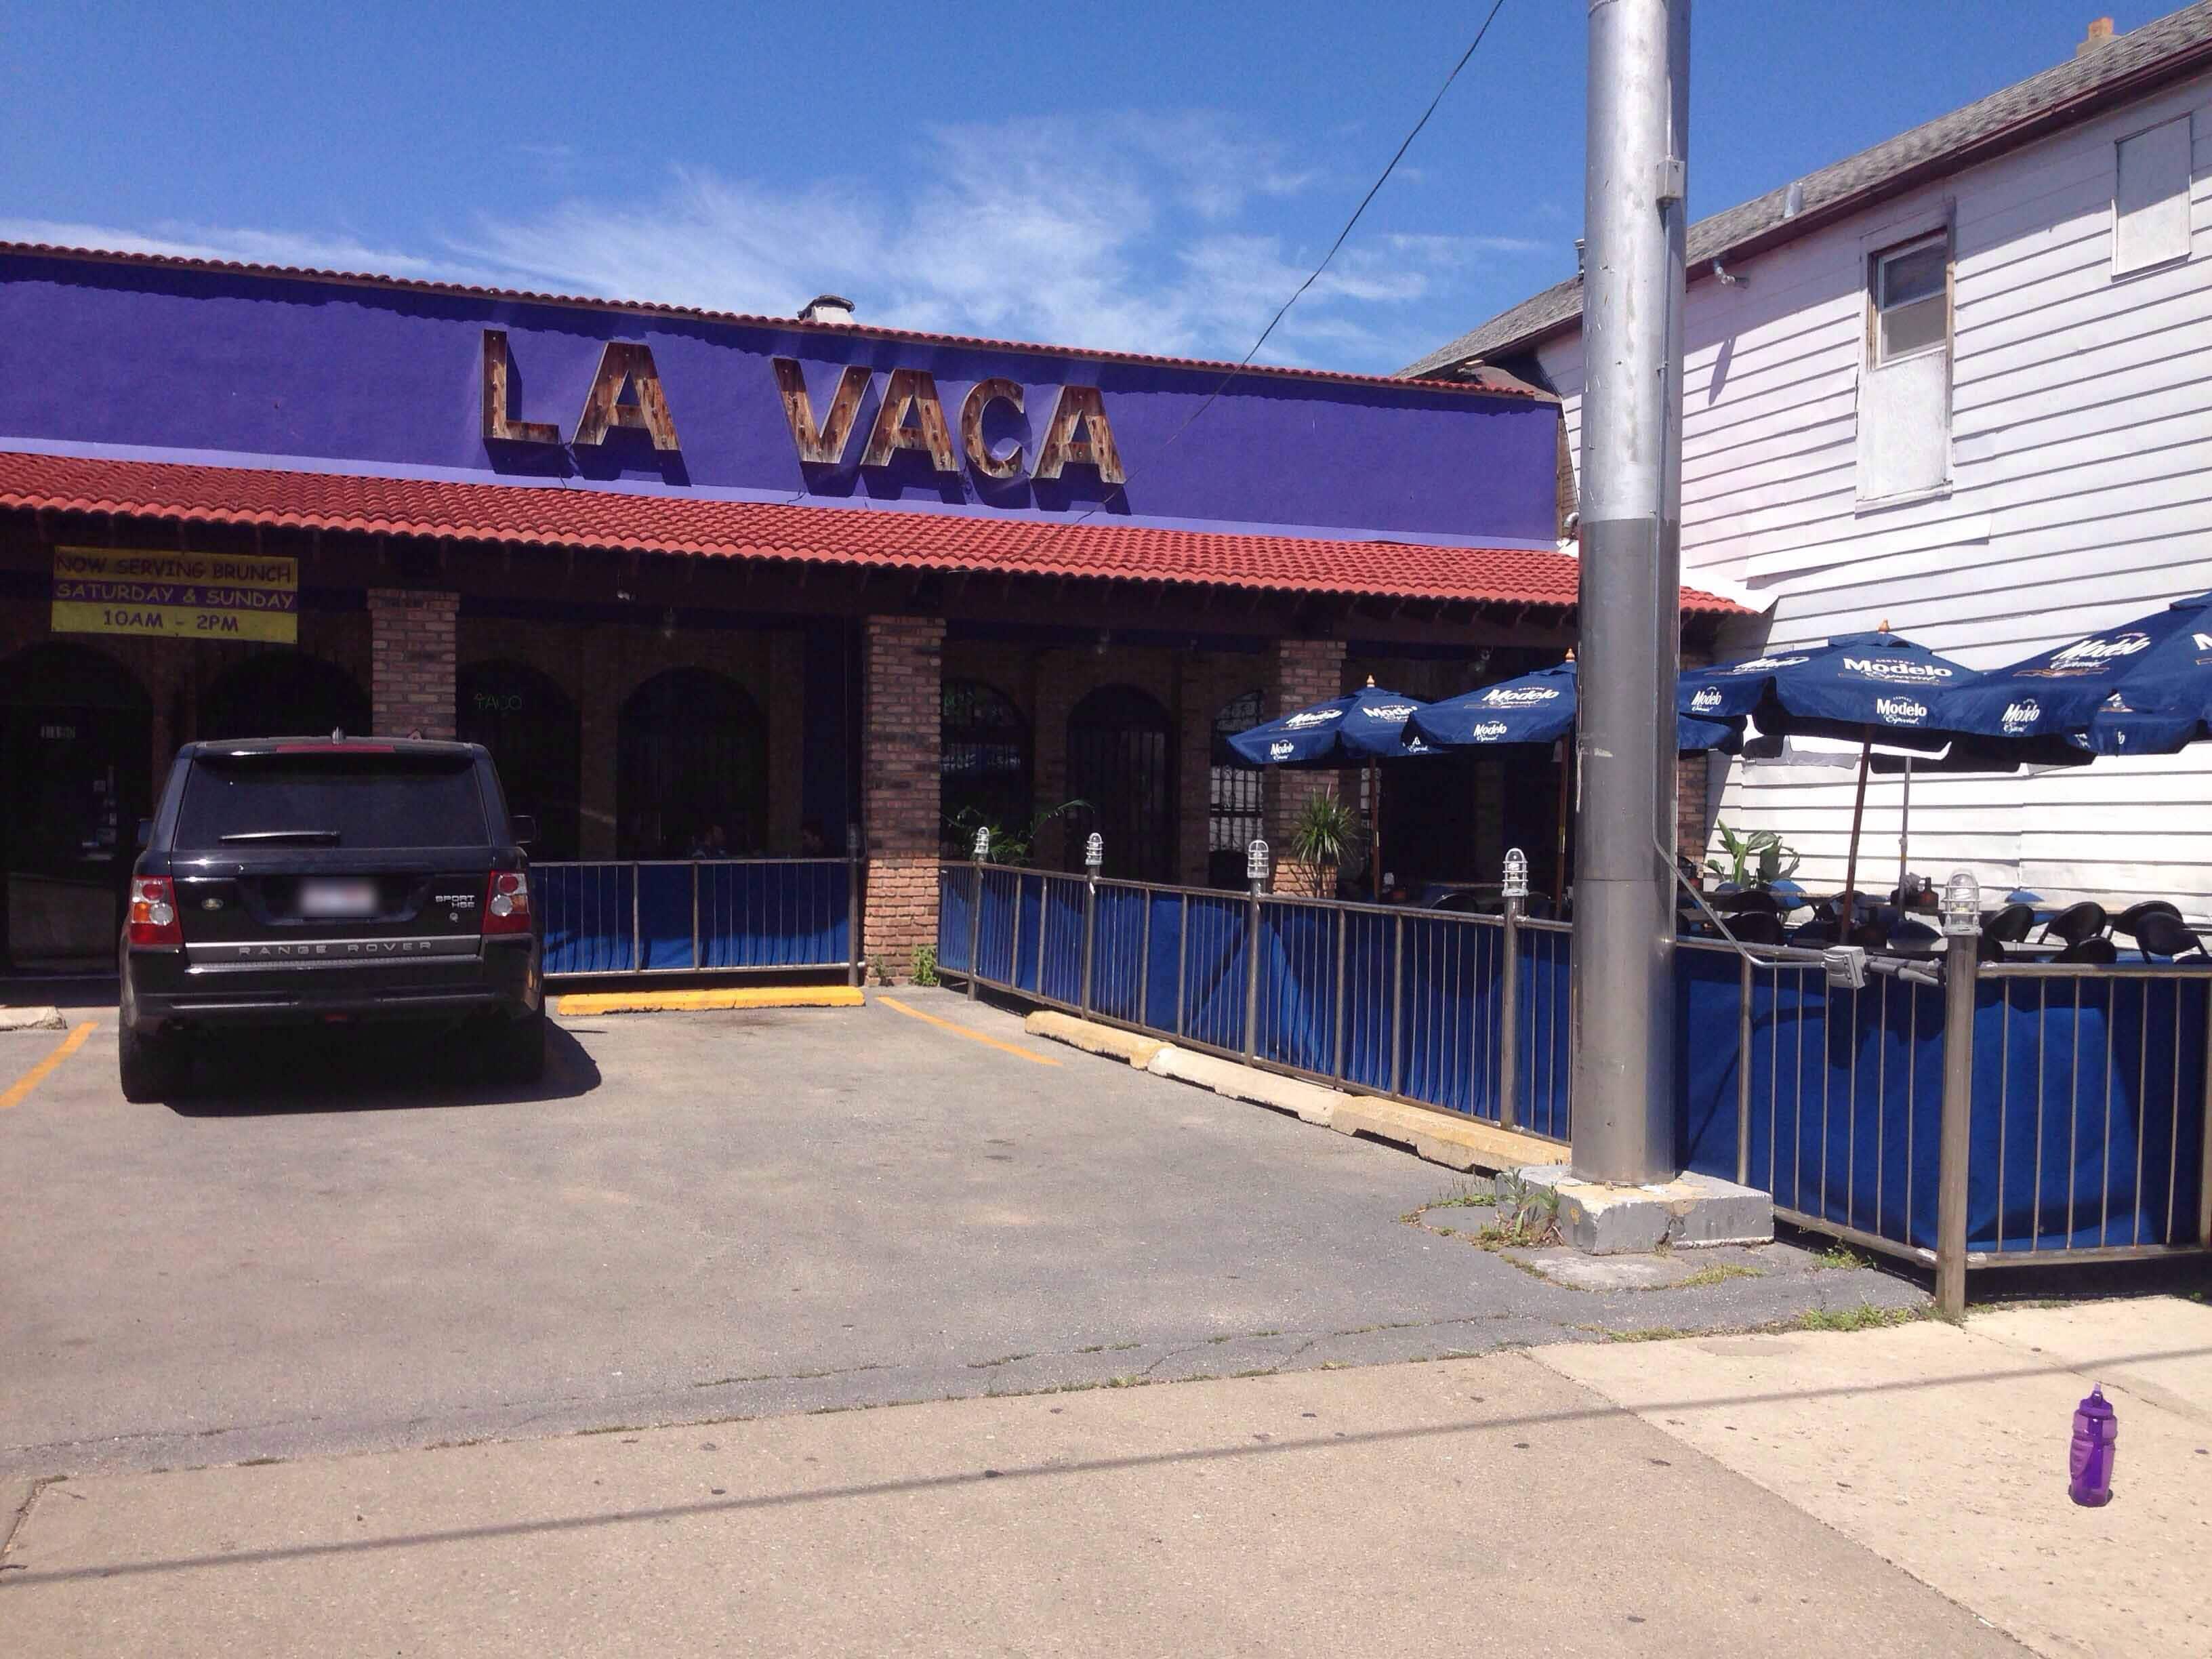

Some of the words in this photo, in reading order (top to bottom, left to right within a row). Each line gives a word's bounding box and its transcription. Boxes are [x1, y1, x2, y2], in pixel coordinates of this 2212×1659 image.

[483, 329, 682, 451] LA
[772, 356, 1126, 484] VACA
[56, 554, 106, 573] NOW
[115, 558, 205, 577] SERVING
[213, 562, 291, 583] BRUNCH
[56, 581, 174, 602] SATURDAY
[183, 589, 197, 603] &
[205, 590, 294, 609] SUNDAY
[104, 609, 163, 629] 10AM
[197, 615, 239, 632] 2PM
[1843, 658, 1952, 676] Modelo
[1481, 689, 1560, 701] Modelo
[1691, 691, 1722, 705] Modelo
[1876, 698, 1927, 716] Modelo
[1473, 722, 1507, 737] Modelo
[435, 895, 475, 903] SPORT
[239, 945, 327, 956] RANGE
[347, 941, 432, 953] ROVER
